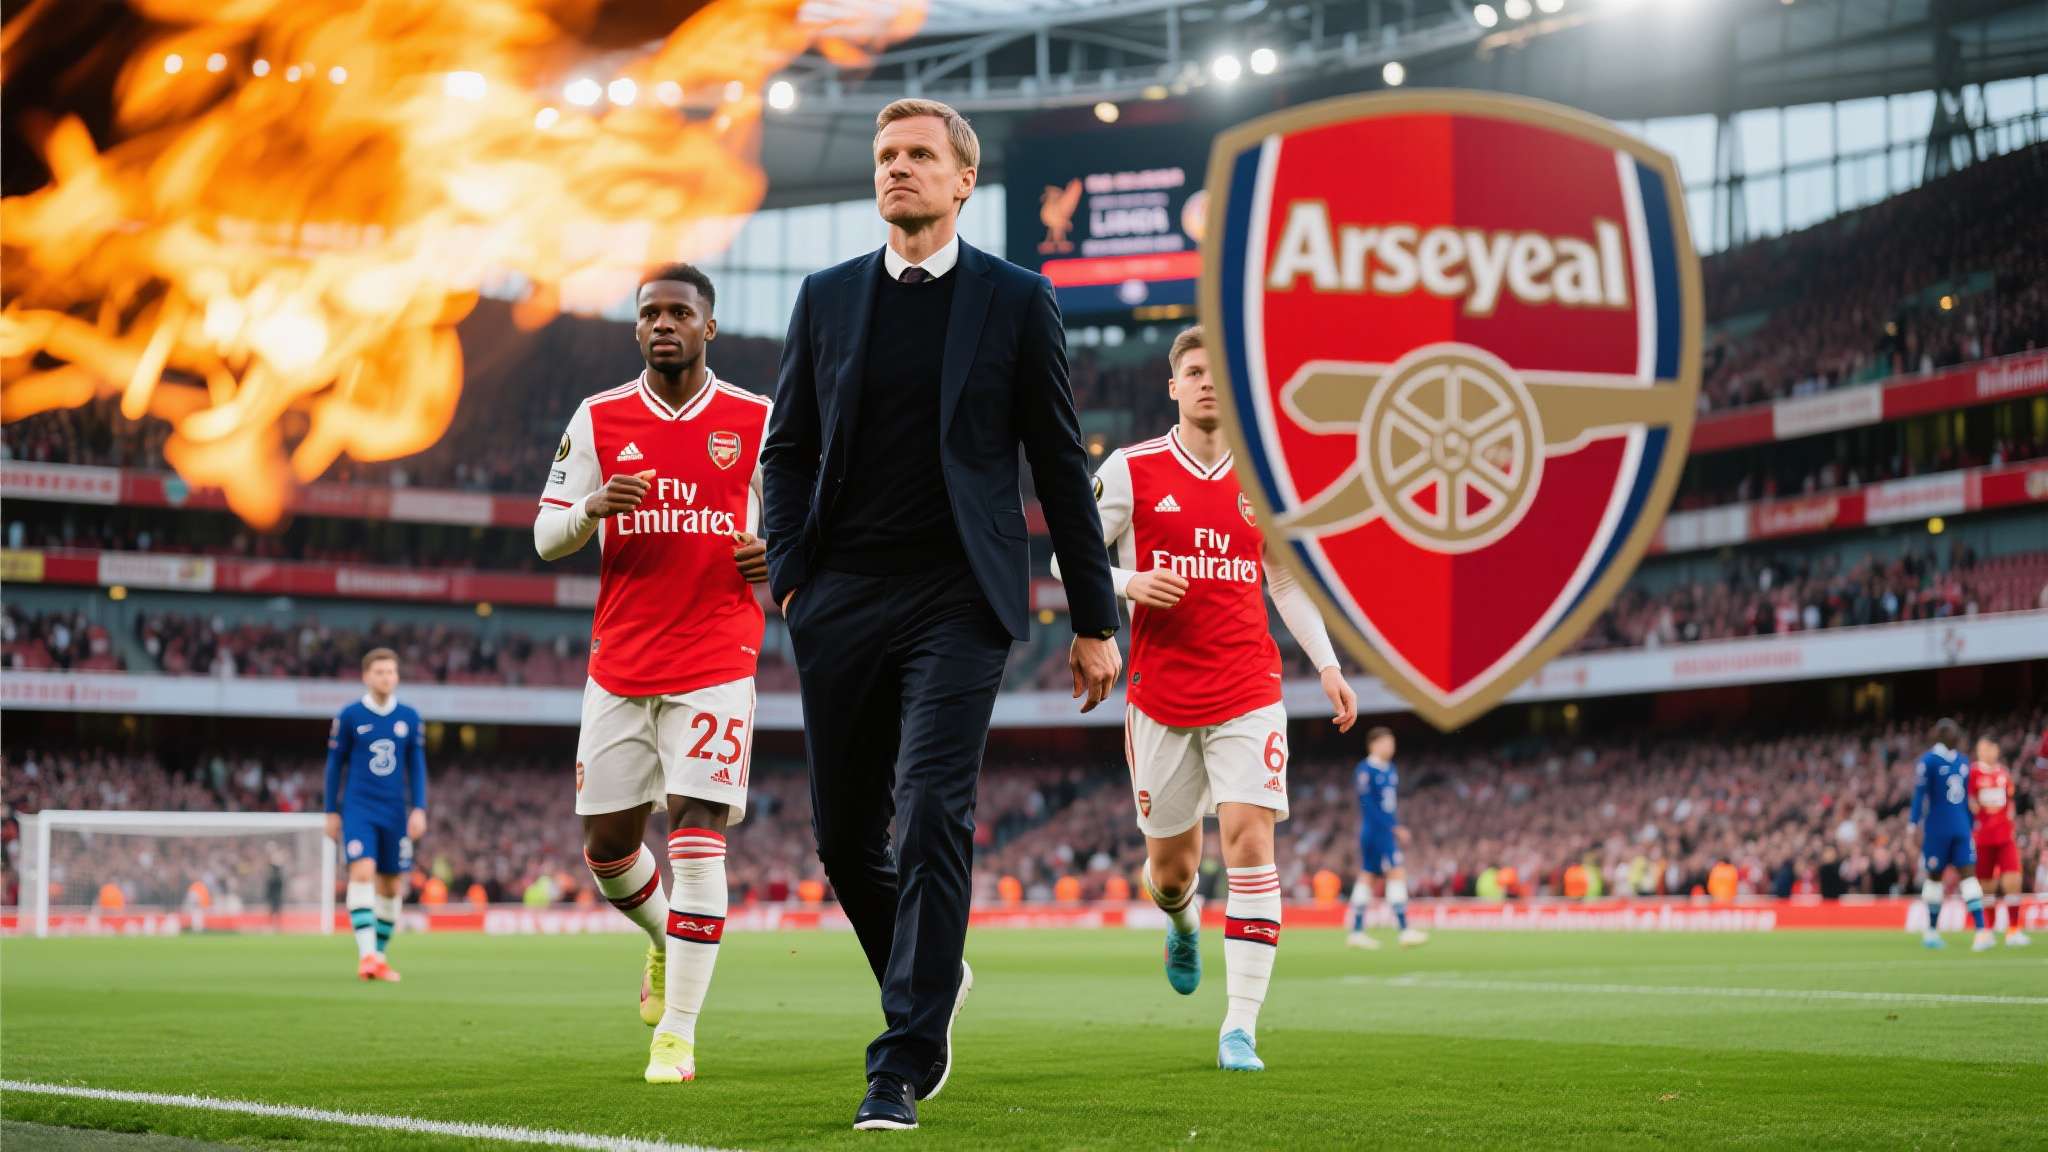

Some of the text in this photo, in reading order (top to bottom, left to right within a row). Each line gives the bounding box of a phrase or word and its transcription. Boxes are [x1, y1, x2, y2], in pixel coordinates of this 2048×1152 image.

[657, 478, 697, 505] Fly
[617, 503, 735, 536] Emirates
[1194, 527, 1230, 554] Fly
[1152, 550, 1258, 583] Emirates
[686, 712, 744, 765] 25
[1264, 731, 1284, 774] 6
[369, 738, 397, 776] 3
